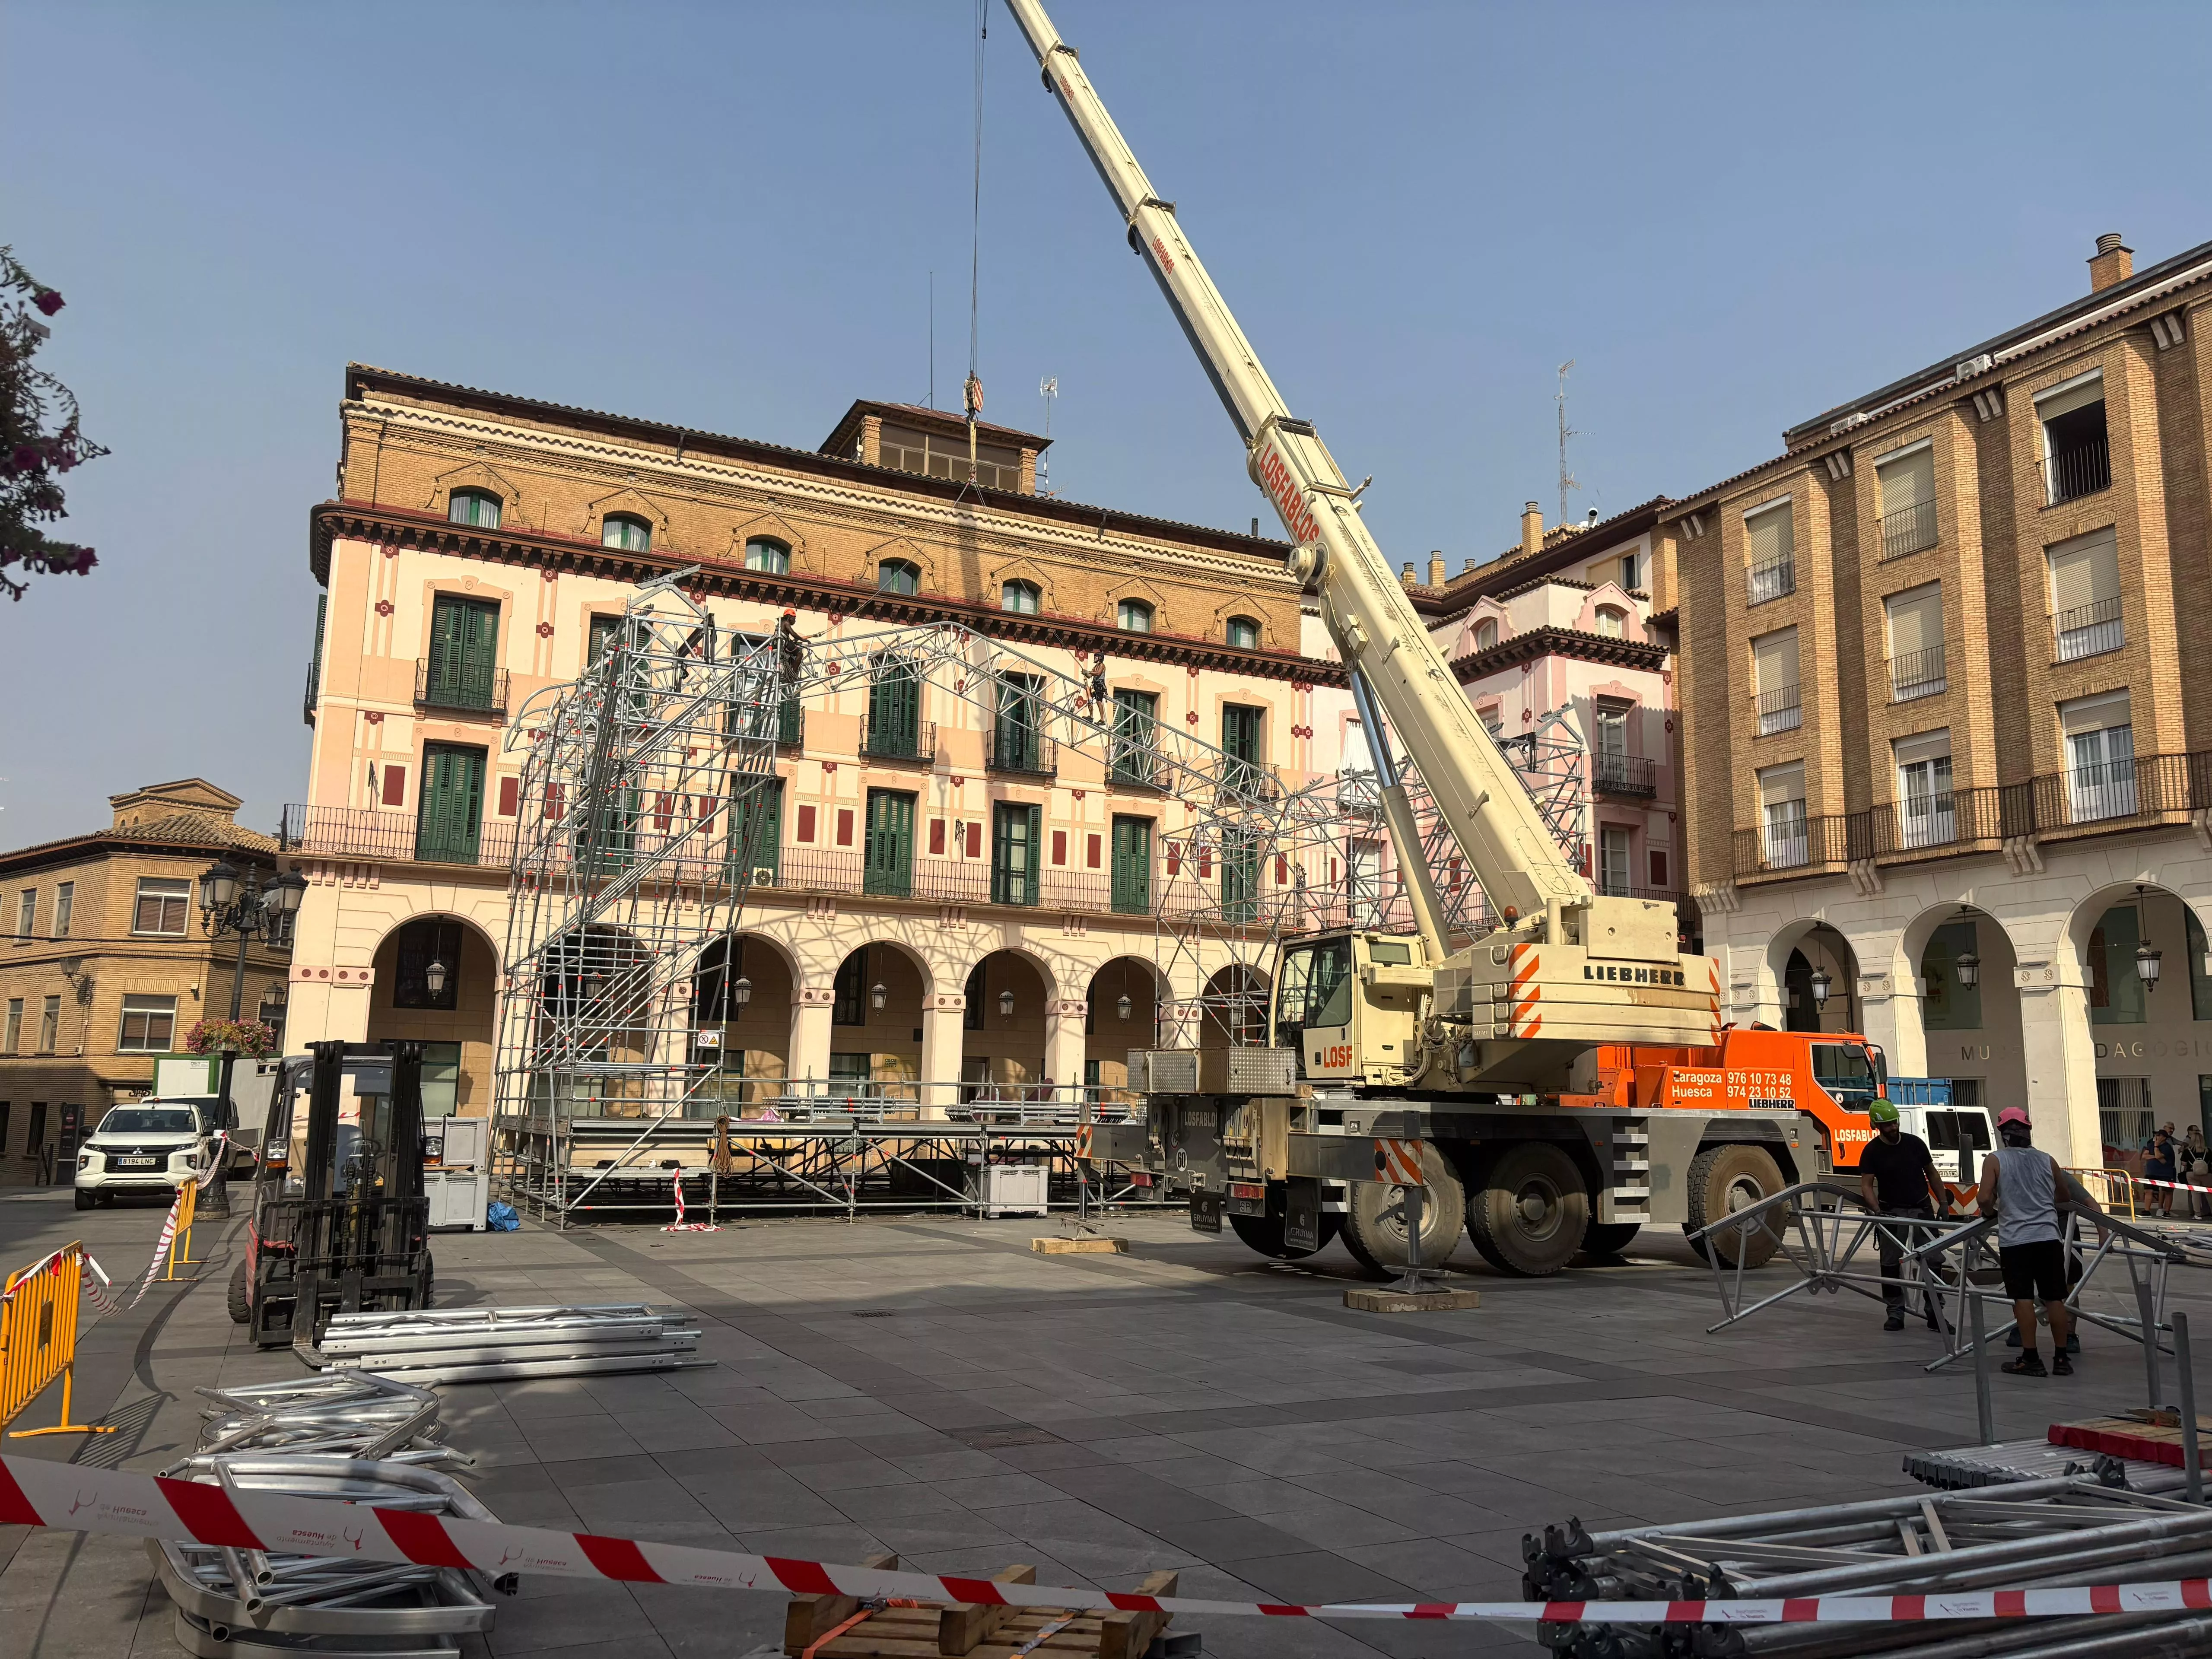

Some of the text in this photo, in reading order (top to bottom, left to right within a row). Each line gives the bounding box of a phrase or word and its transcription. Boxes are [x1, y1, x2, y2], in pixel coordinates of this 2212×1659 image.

[1259, 442, 1319, 542] LOSFABLOS
[1584, 966, 1684, 986] LIEBHERR
[1324, 1045, 1352, 1068] LOSF
[1672, 1070, 1792, 1085] Zaragoza 976 10 73 48
[1672, 1085, 1791, 1098] Huesca 974 23 10 52
[1749, 1099, 1794, 1109] LIEBHERR
[1185, 1111, 1217, 1127] LOSFABLO
[1178, 1152, 1186, 1168] 60
[1193, 1214, 1217, 1224] GRUYMA
[292, 1530, 324, 1540] Huesca
